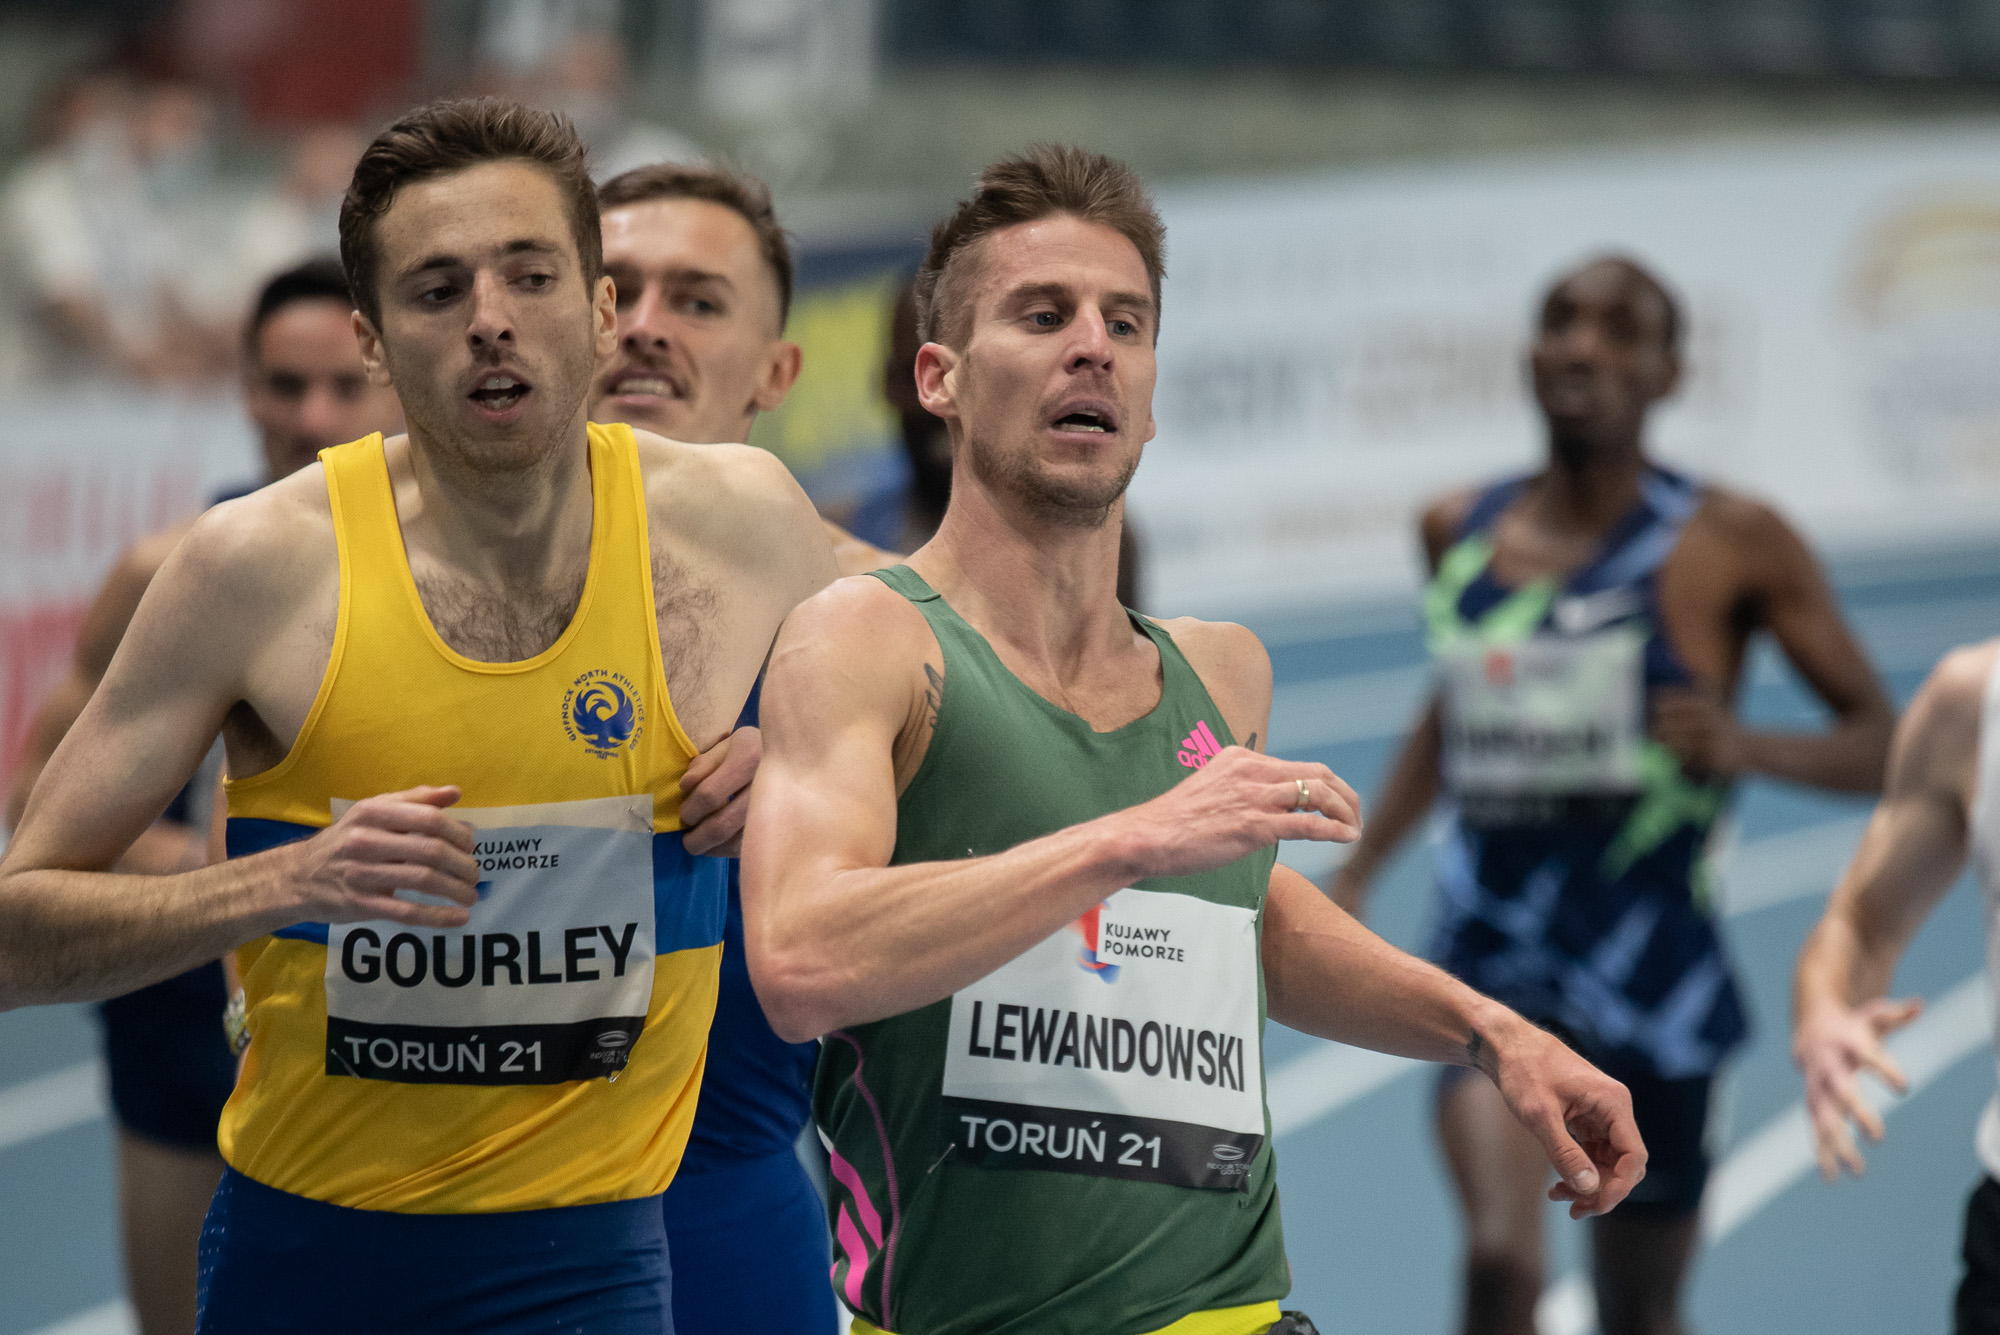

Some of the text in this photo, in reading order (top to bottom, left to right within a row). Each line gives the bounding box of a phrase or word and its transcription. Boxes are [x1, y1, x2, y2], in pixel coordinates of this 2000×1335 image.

[573, 669, 608, 687] NORTH
[612, 672, 645, 722] ATHLETICS
[341, 922, 639, 988] GOURLEY
[1105, 922, 1171, 943] KUJAWY
[1105, 940, 1184, 963] POMORZE
[344, 1034, 542, 1073] TORUŃ 21
[968, 1000, 1245, 1092] LEWANDOWSKI
[960, 1115, 1161, 1168] TORUŃ 21
